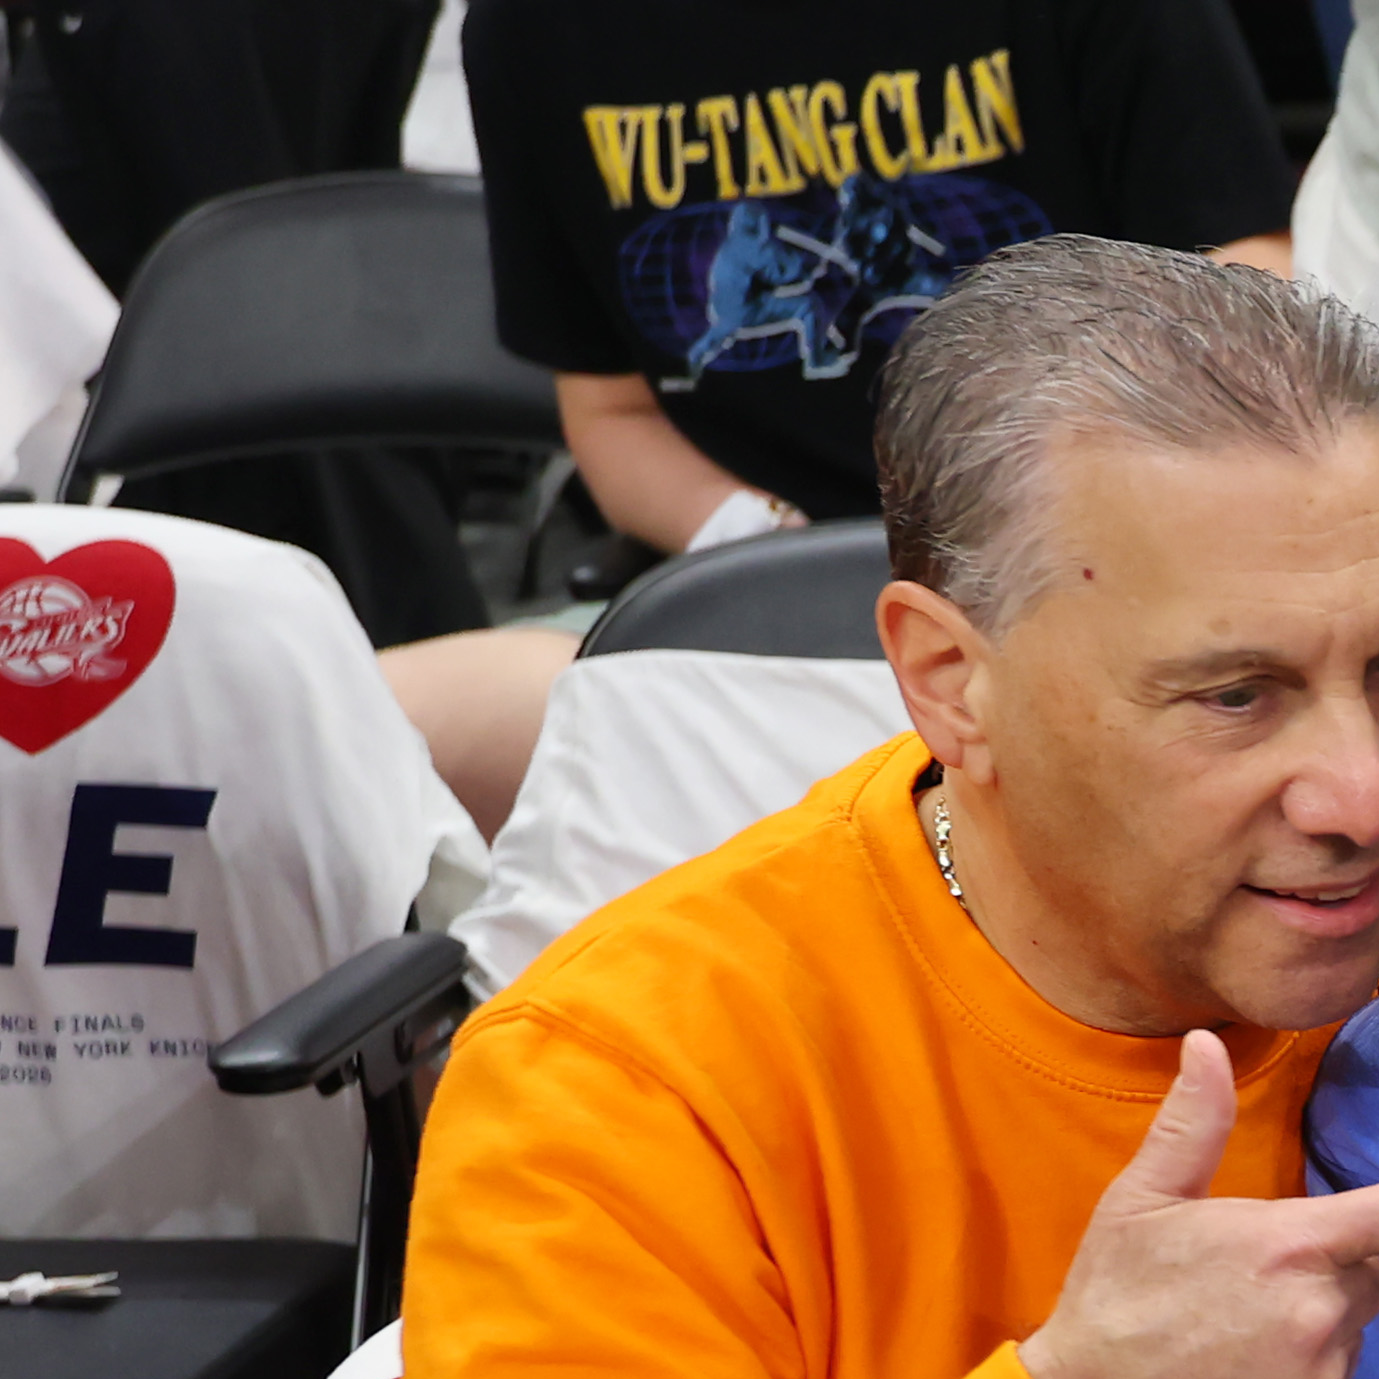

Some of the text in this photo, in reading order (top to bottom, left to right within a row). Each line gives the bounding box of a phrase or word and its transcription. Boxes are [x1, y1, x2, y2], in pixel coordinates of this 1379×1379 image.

[583, 48, 1025, 210] WU-TANG CLAN
[148, 1037, 208, 1059] KNIC
